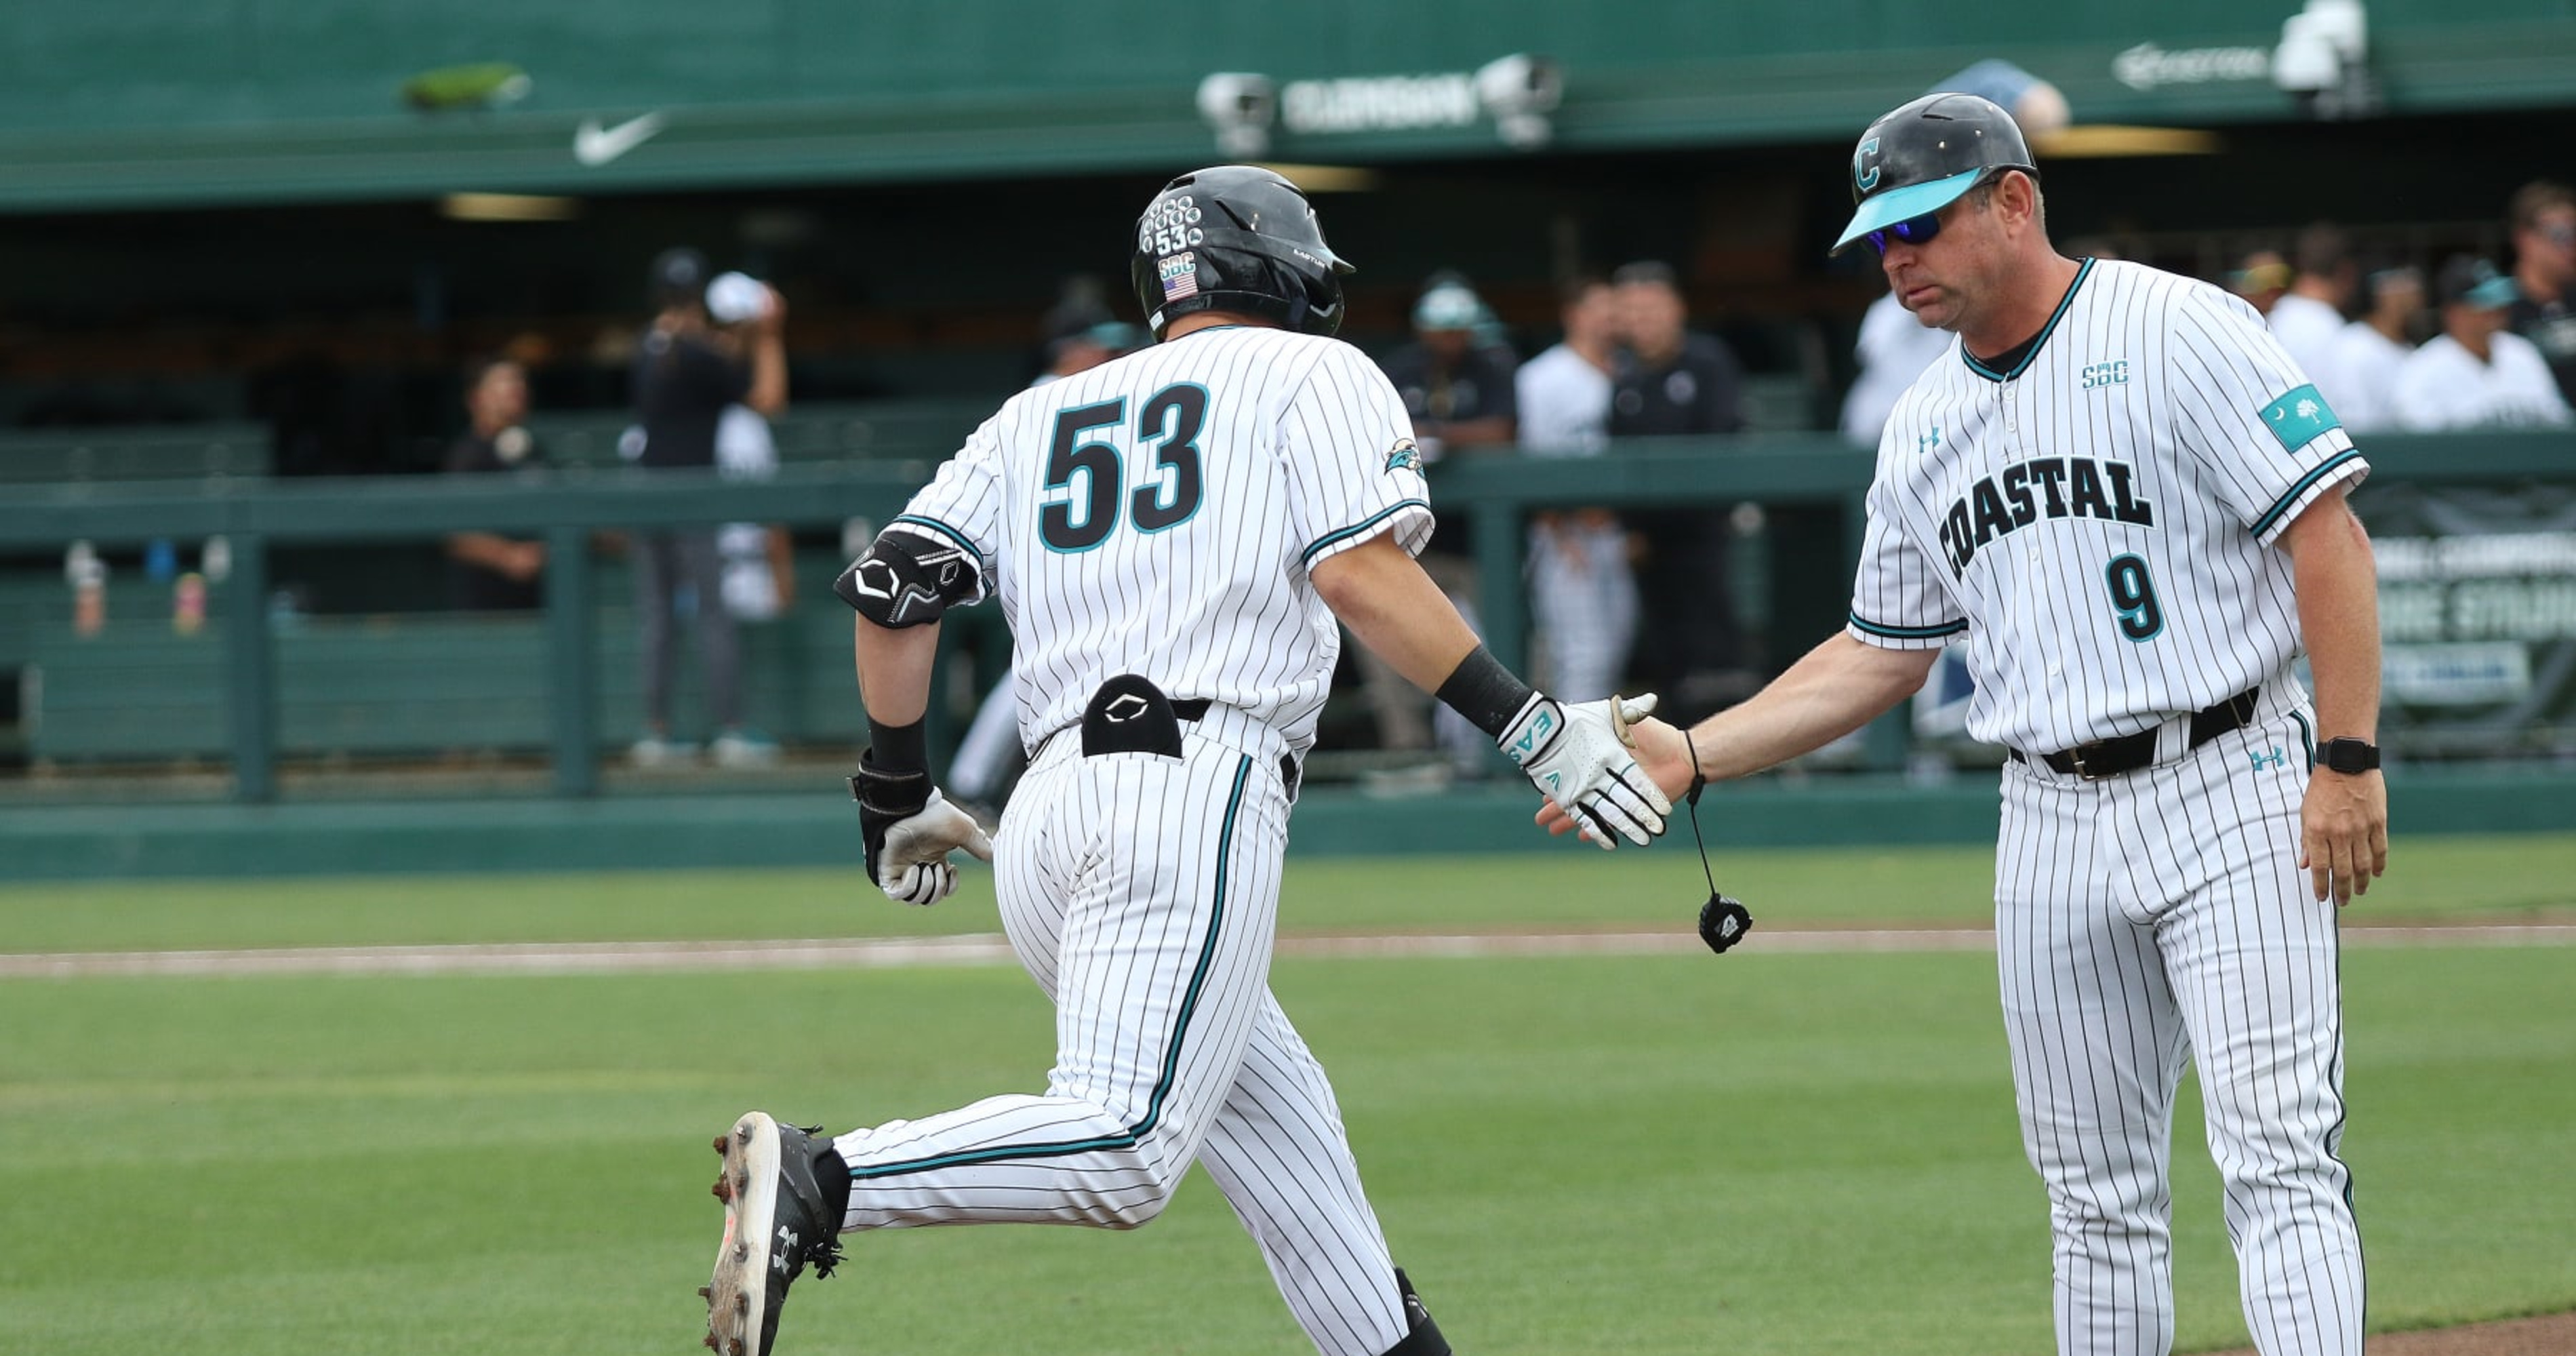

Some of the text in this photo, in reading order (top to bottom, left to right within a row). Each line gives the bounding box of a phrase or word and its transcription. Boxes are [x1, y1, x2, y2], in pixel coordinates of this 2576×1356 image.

[1855, 137, 1880, 191] C
[1155, 224, 1187, 256] 53
[1158, 252, 1196, 281] SBC
[2082, 359, 2130, 389] SBC
[1038, 380, 1209, 554] 53
[1938, 455, 2157, 584] COASTAL
[2105, 551, 2165, 643] 9
